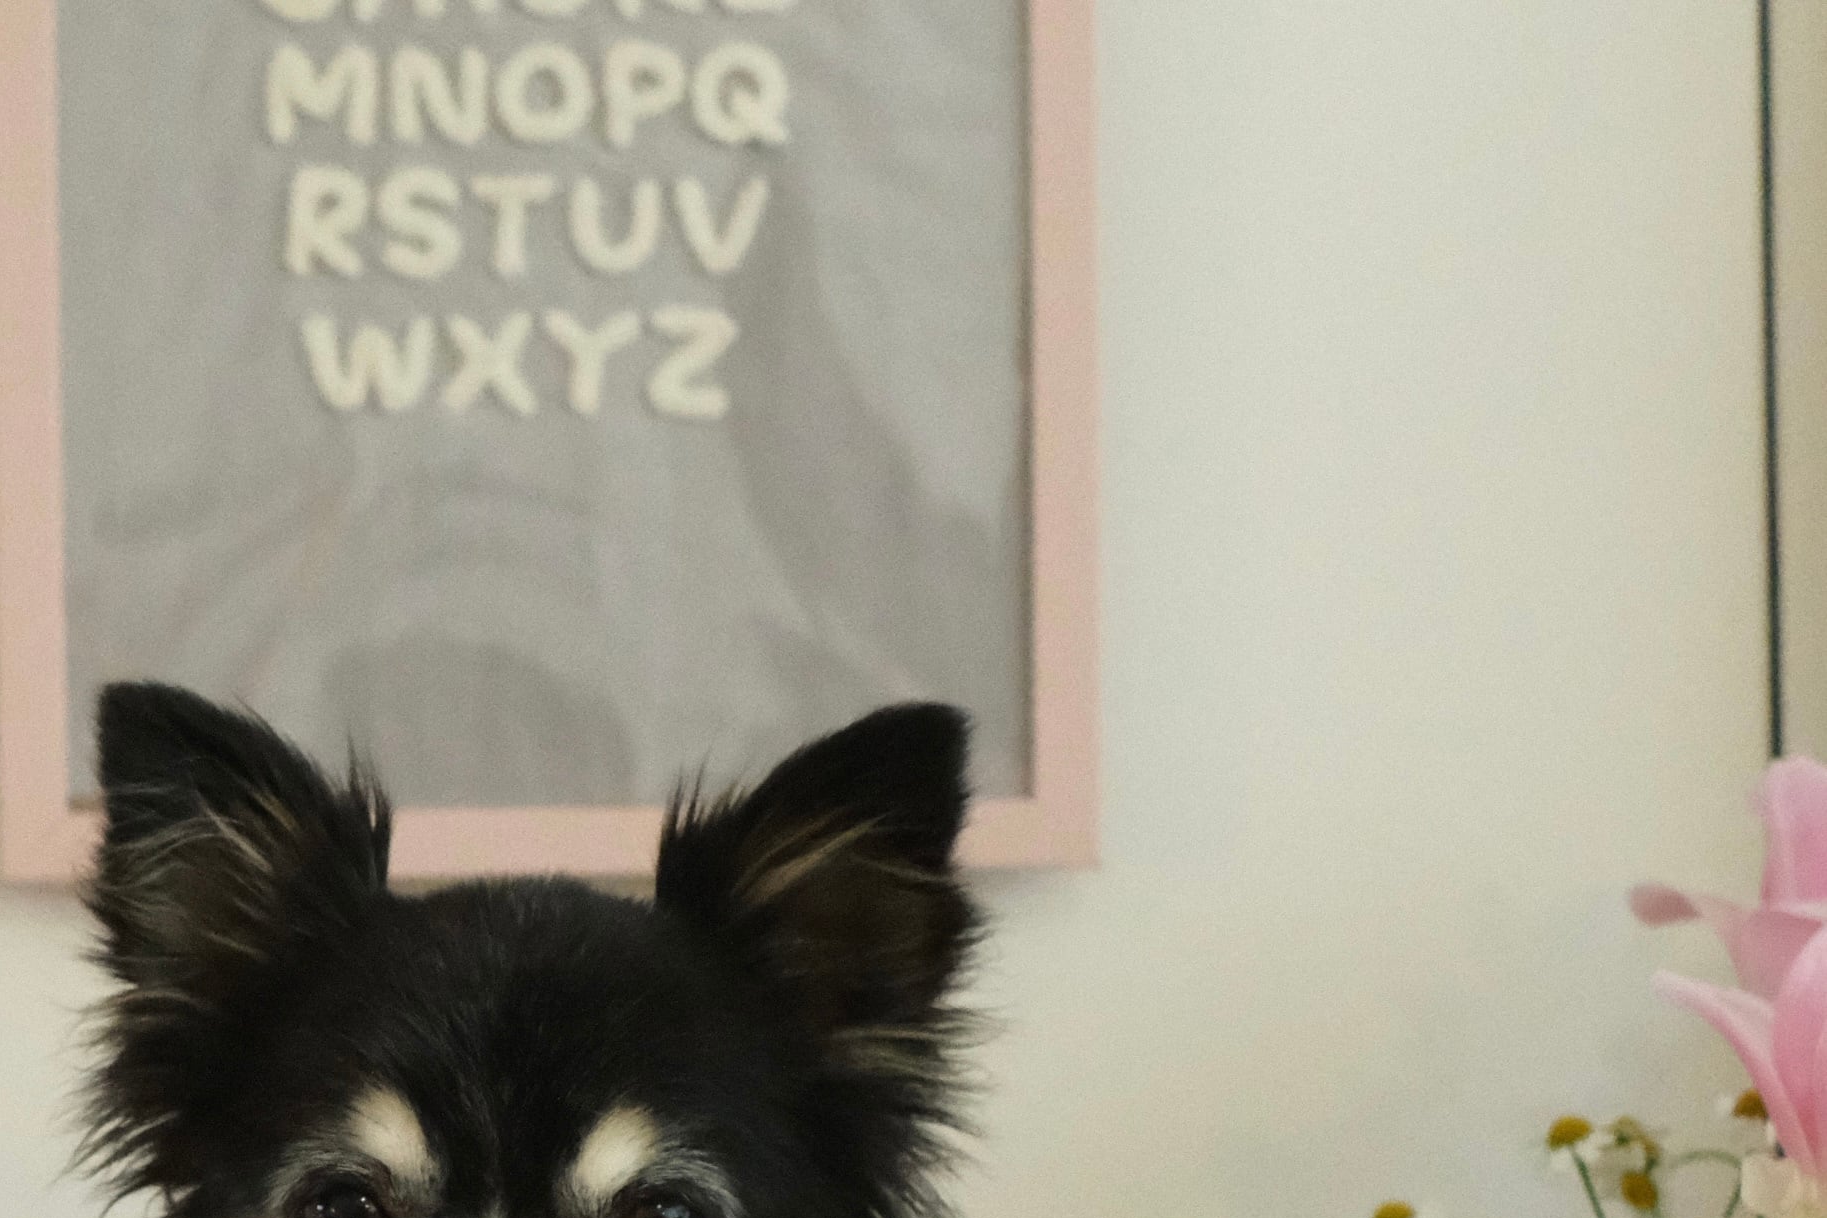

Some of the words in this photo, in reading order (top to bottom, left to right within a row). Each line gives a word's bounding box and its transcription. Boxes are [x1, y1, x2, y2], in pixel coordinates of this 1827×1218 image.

[267, 40, 789, 146] MNOPQ
[285, 165, 771, 278] RSTUV
[301, 306, 739, 419] WXYZ
